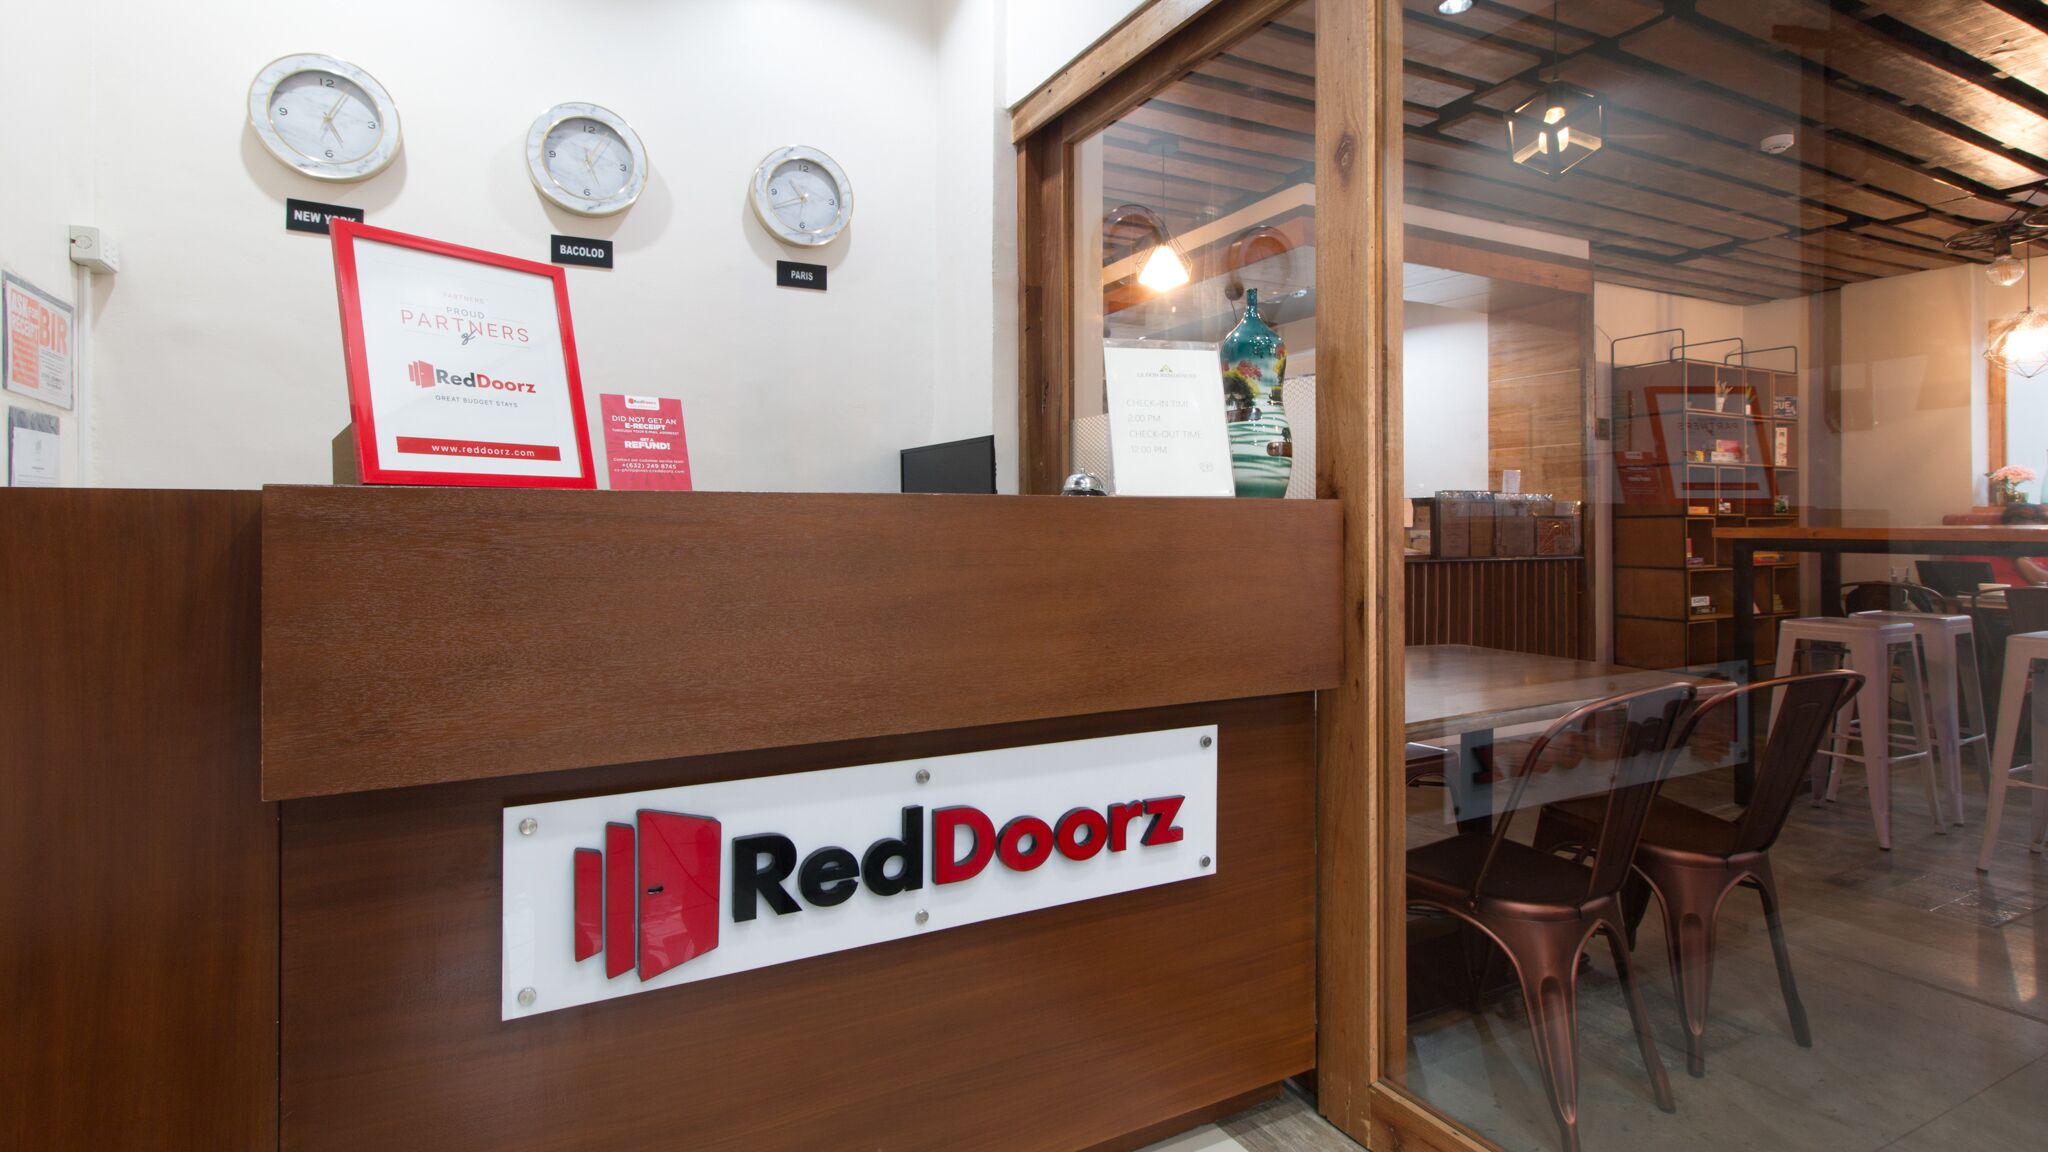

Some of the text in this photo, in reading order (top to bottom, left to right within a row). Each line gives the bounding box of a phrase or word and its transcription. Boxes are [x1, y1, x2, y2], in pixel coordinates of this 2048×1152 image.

[319, 78, 335, 89] 12
[279, 107, 288, 116] 9
[367, 121, 376, 130] 3
[583, 125, 596, 135] 12
[325, 149, 334, 158] 6
[548, 150, 557, 158] 9
[620, 164, 627, 172] 3
[799, 164, 809, 173] 12
[583, 188, 591, 196] 6
[771, 188, 778, 196] 9
[828, 198, 835, 206] 3
[294, 209, 321, 224] NEW
[799, 221, 806, 229] 6
[559, 244, 605, 259] BACOLOD
[790, 270, 814, 281] PARIS
[446, 306, 486, 320] PROUD
[40, 306, 67, 355] BIR
[400, 308, 530, 343] PARTNERS
[435, 367, 537, 394] RedDoorz
[434, 395, 519, 408] GREAT BUDGET STAYS
[624, 422, 665, 430] E-RECEIPT
[624, 440, 670, 450] REFUND!
[431, 444, 536, 458] www.reddoorz.com
[732, 795, 1186, 922] RedDoorz
